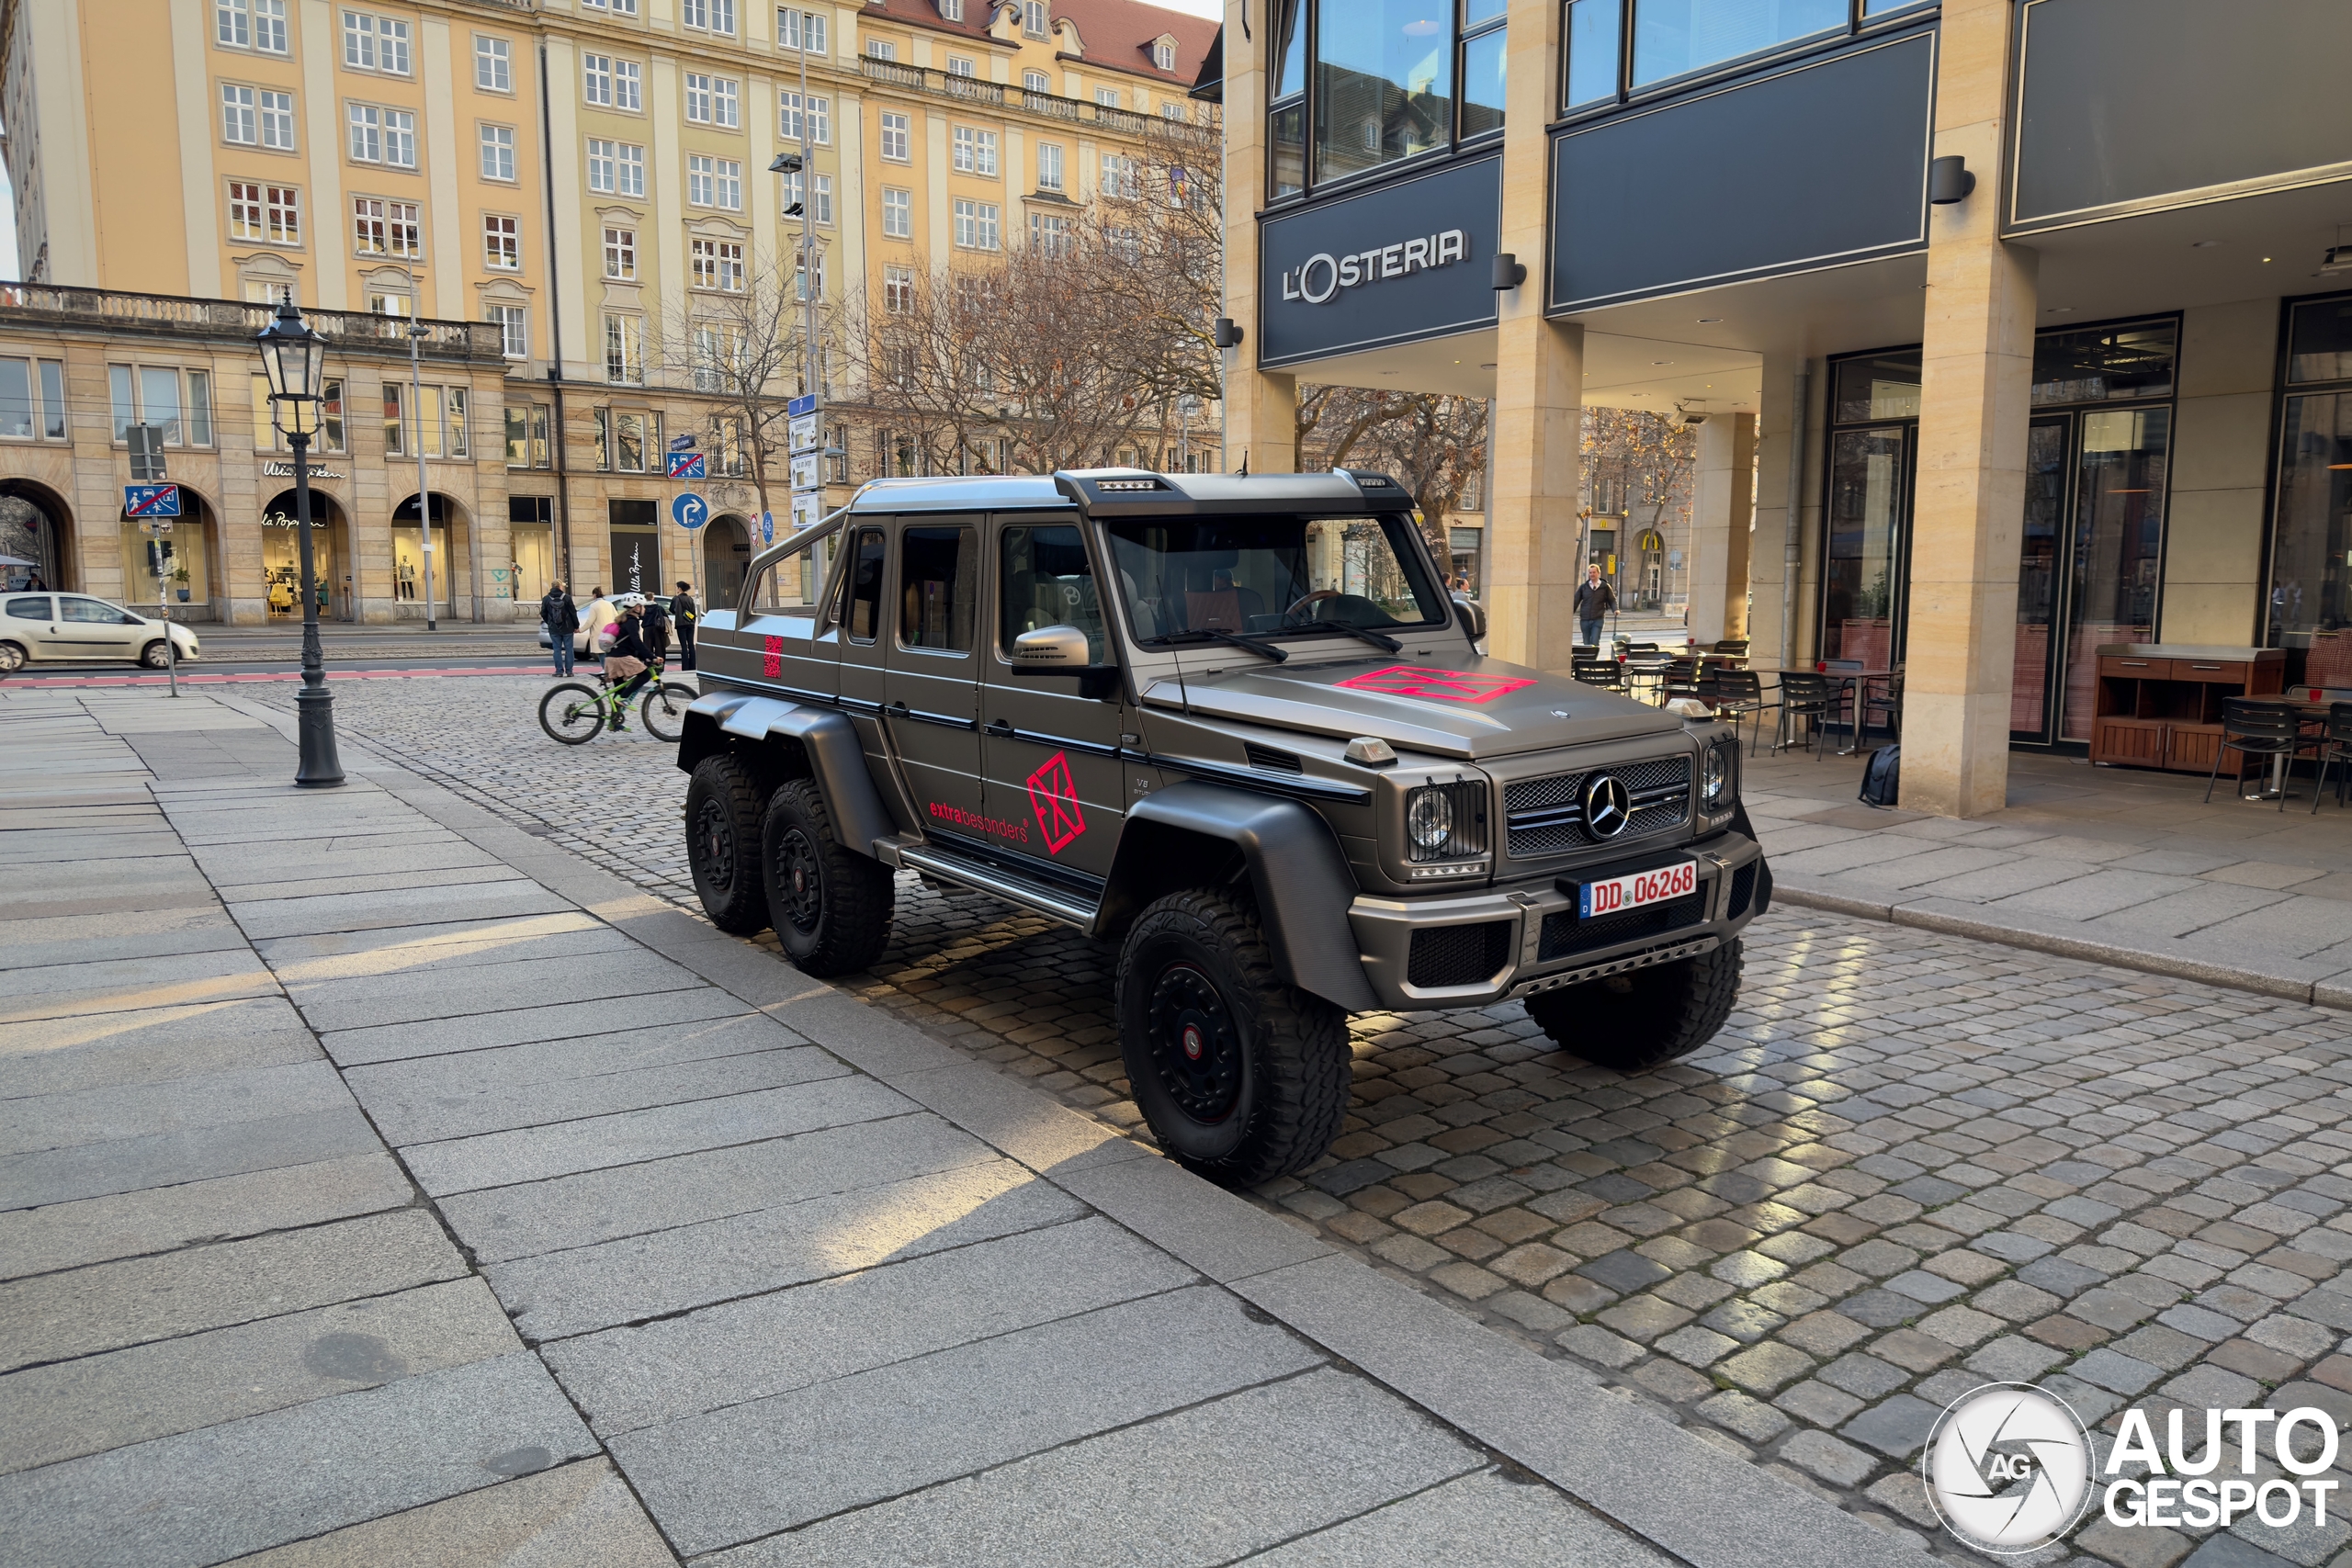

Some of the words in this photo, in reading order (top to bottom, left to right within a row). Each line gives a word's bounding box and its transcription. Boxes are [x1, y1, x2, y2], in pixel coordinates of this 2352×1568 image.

[1283, 229, 1464, 304] L'OSTERIA
[798, 399, 804, 412] P
[628, 541, 643, 574] Popken
[630, 575, 640, 592] Ulla
[1136, 778, 1148, 788] V8
[1594, 882, 1623, 913] DD
[1634, 864, 1693, 904] 06268
[1582, 905, 1589, 914] D
